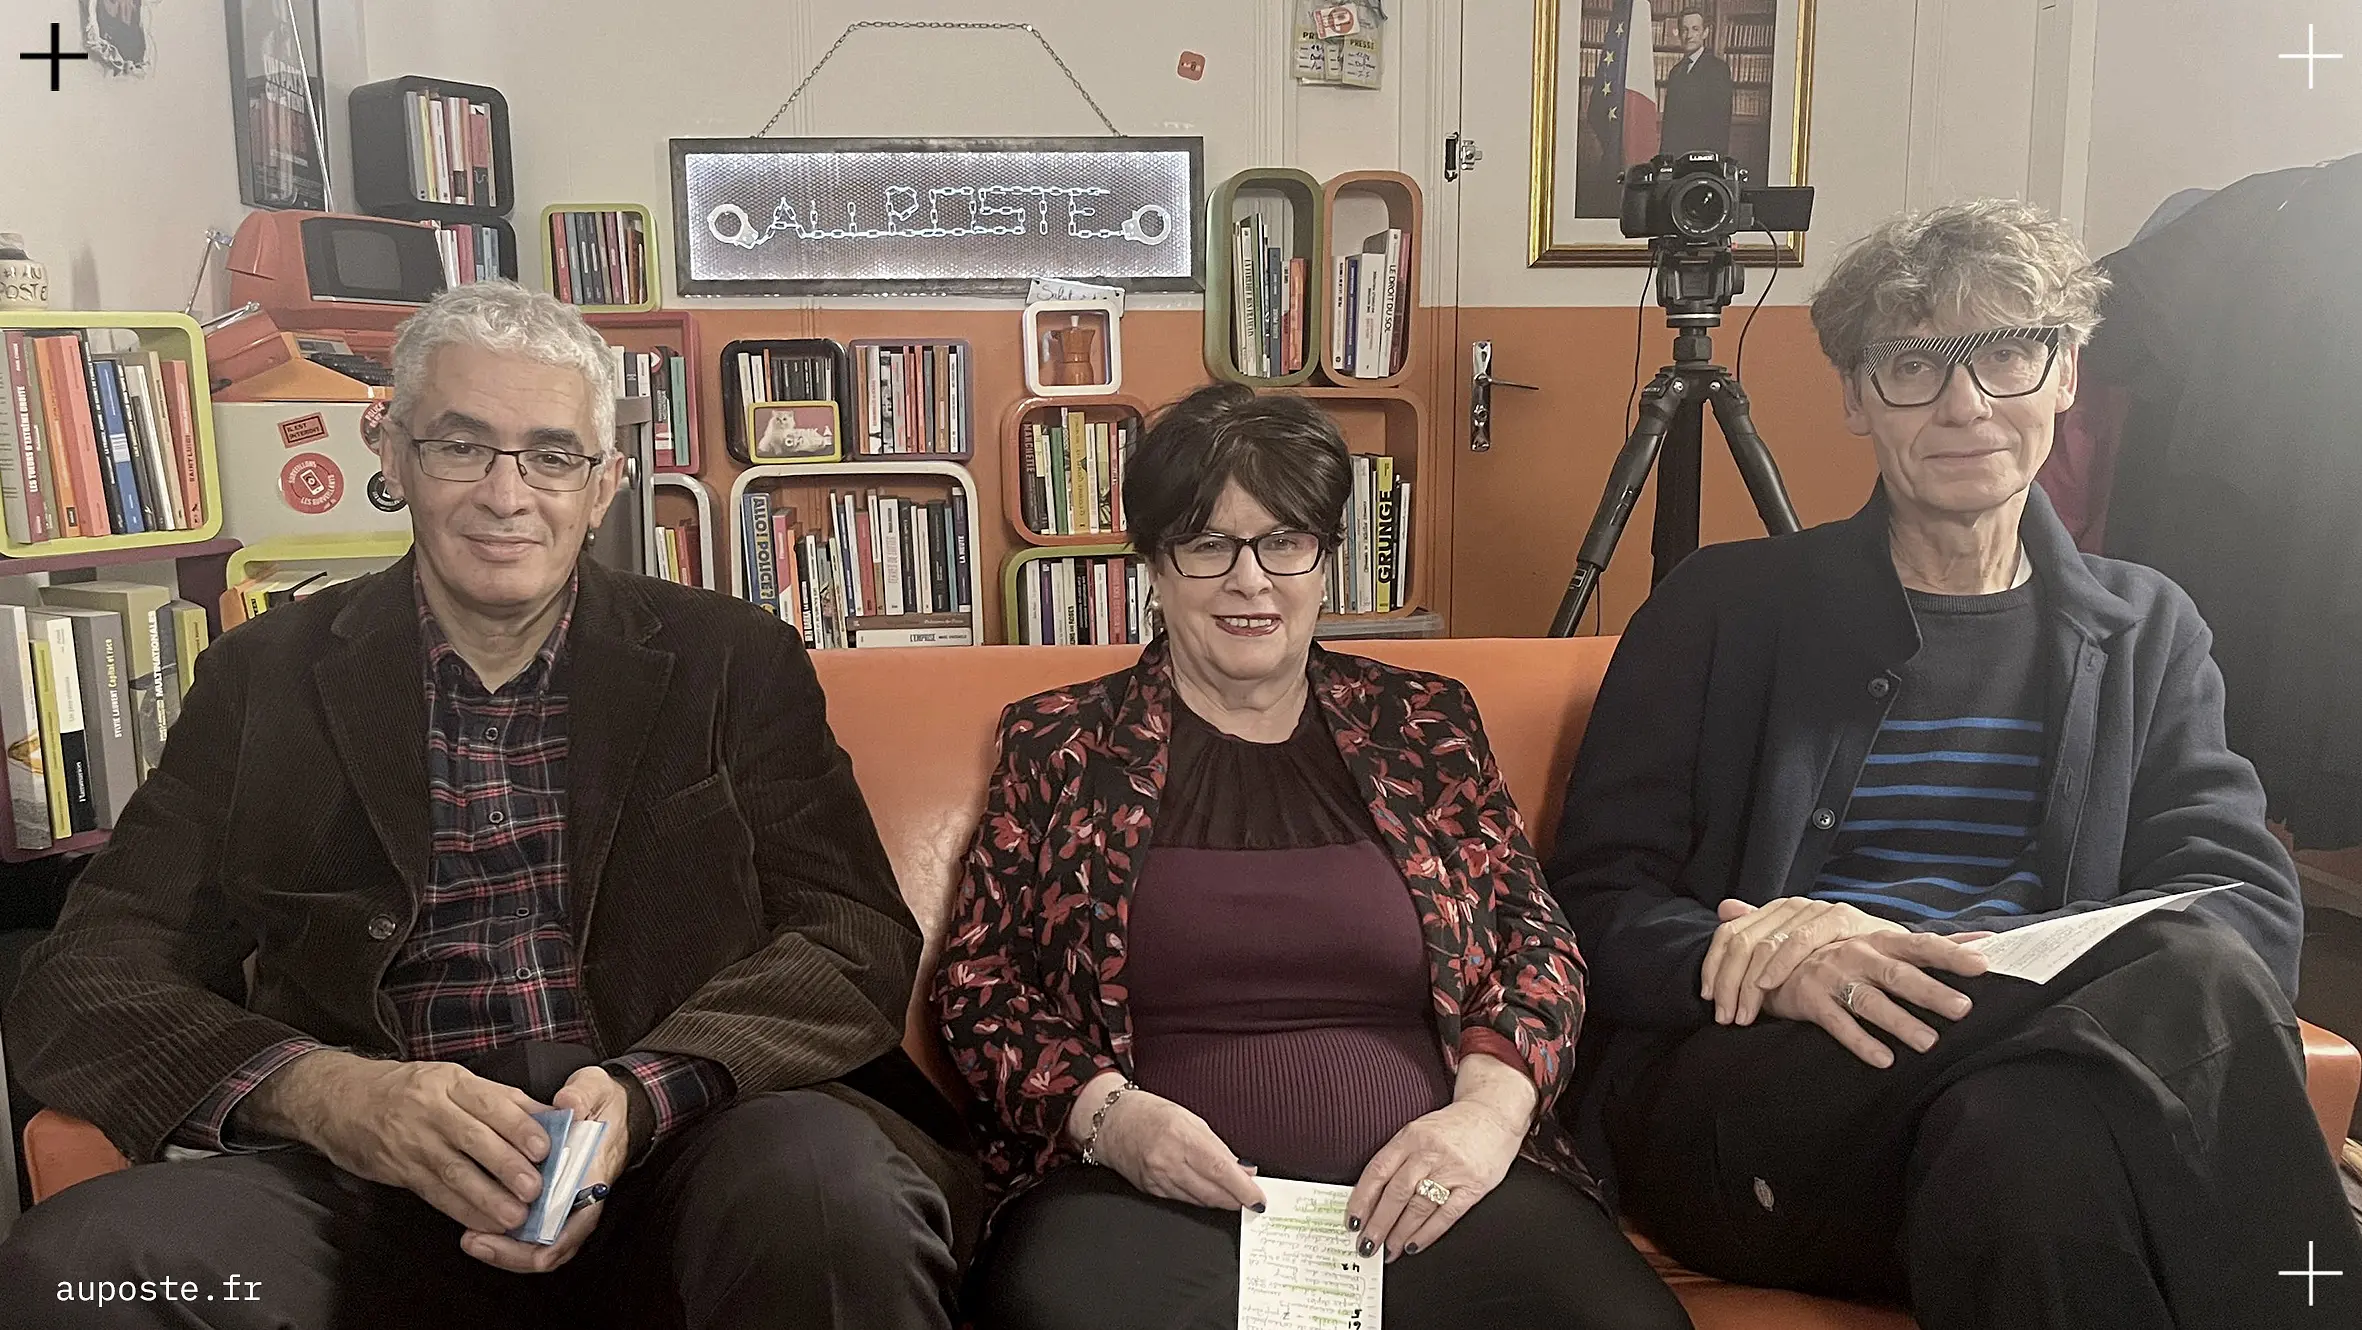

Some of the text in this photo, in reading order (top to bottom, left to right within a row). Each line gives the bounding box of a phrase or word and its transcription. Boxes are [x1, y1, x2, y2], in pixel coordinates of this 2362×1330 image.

[886, 186, 1114, 236] POSTE
[1384, 265, 1396, 333] LE DROIT DU SOL
[17, 386, 38, 493] LES TUEURS D'EXTRÊME DROITE
[752, 497, 774, 599] ALLO! POLICE?
[1377, 490, 1393, 584] GRUNGE
[105, 639, 113, 655] race
[107, 664, 118, 688] Capital
[148, 610, 164, 697] MULTINATIONALES
[110, 690, 120, 716] LAURENT
[113, 717, 122, 738] SYLVIE
